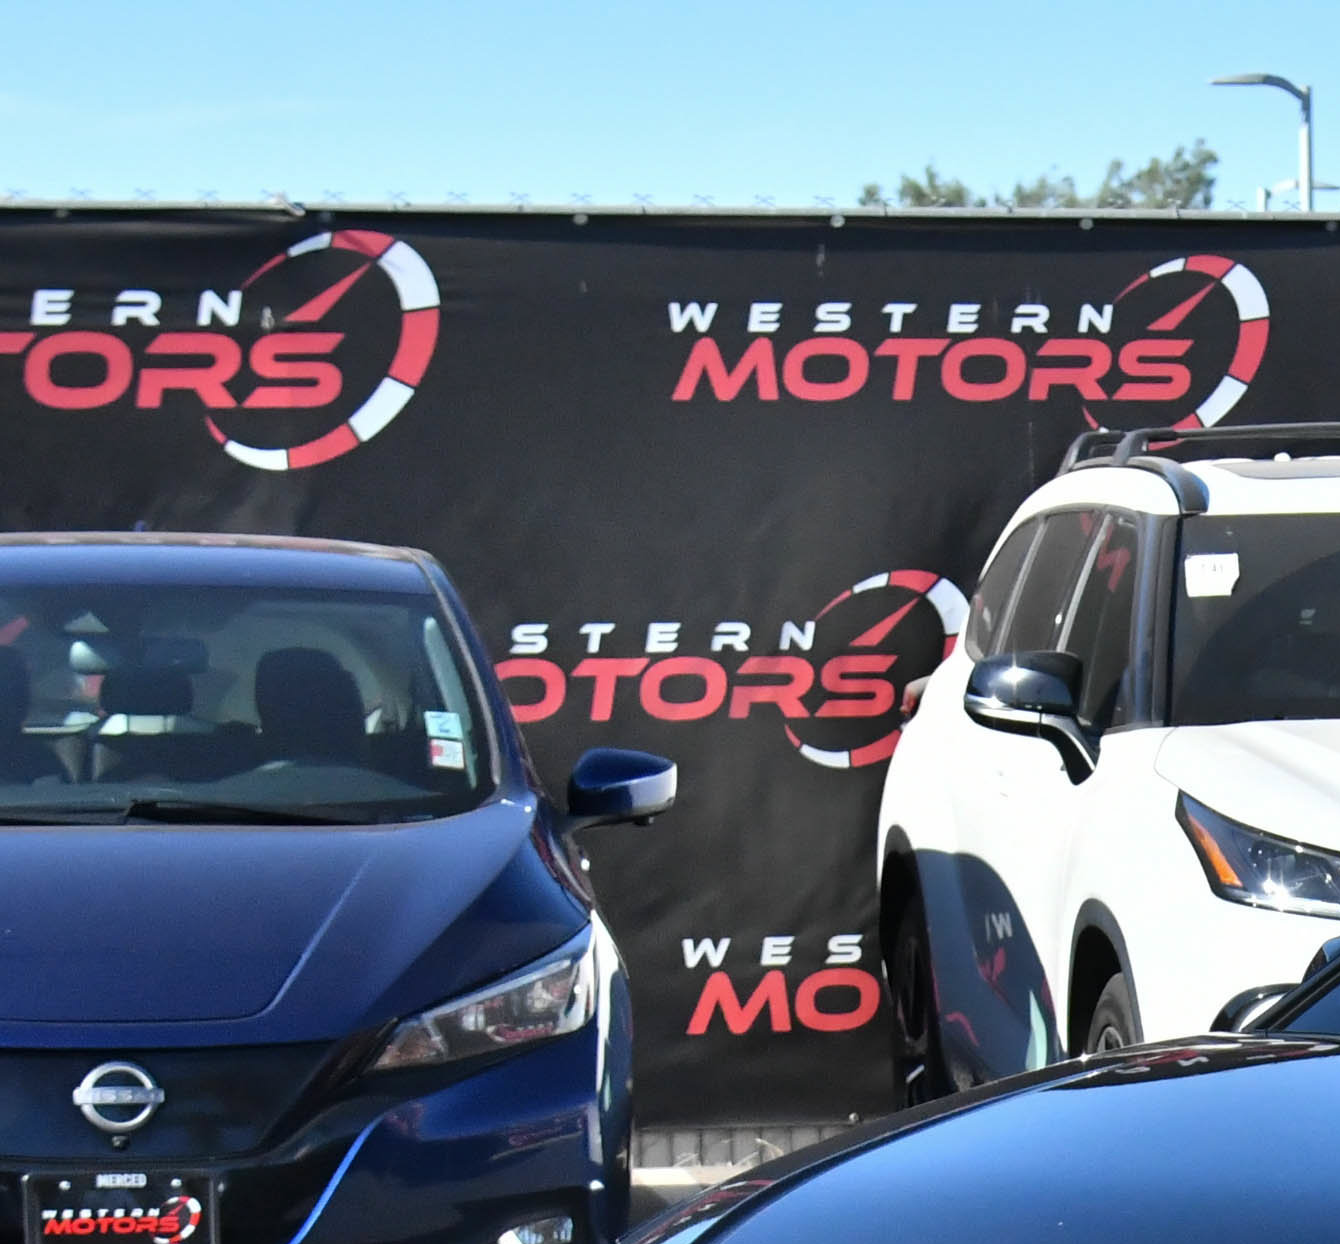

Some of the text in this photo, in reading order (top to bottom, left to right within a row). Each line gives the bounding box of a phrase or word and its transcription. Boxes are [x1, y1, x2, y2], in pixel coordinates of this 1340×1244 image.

[667, 302, 1114, 334] WESTERN
[672, 337, 1195, 401] MOTORS
[510, 621, 816, 654] STERN
[495, 654, 898, 723] OTORS
[682, 934, 864, 970] WES
[686, 967, 880, 1035] MO
[44, 1215, 180, 1235] MOTORS
